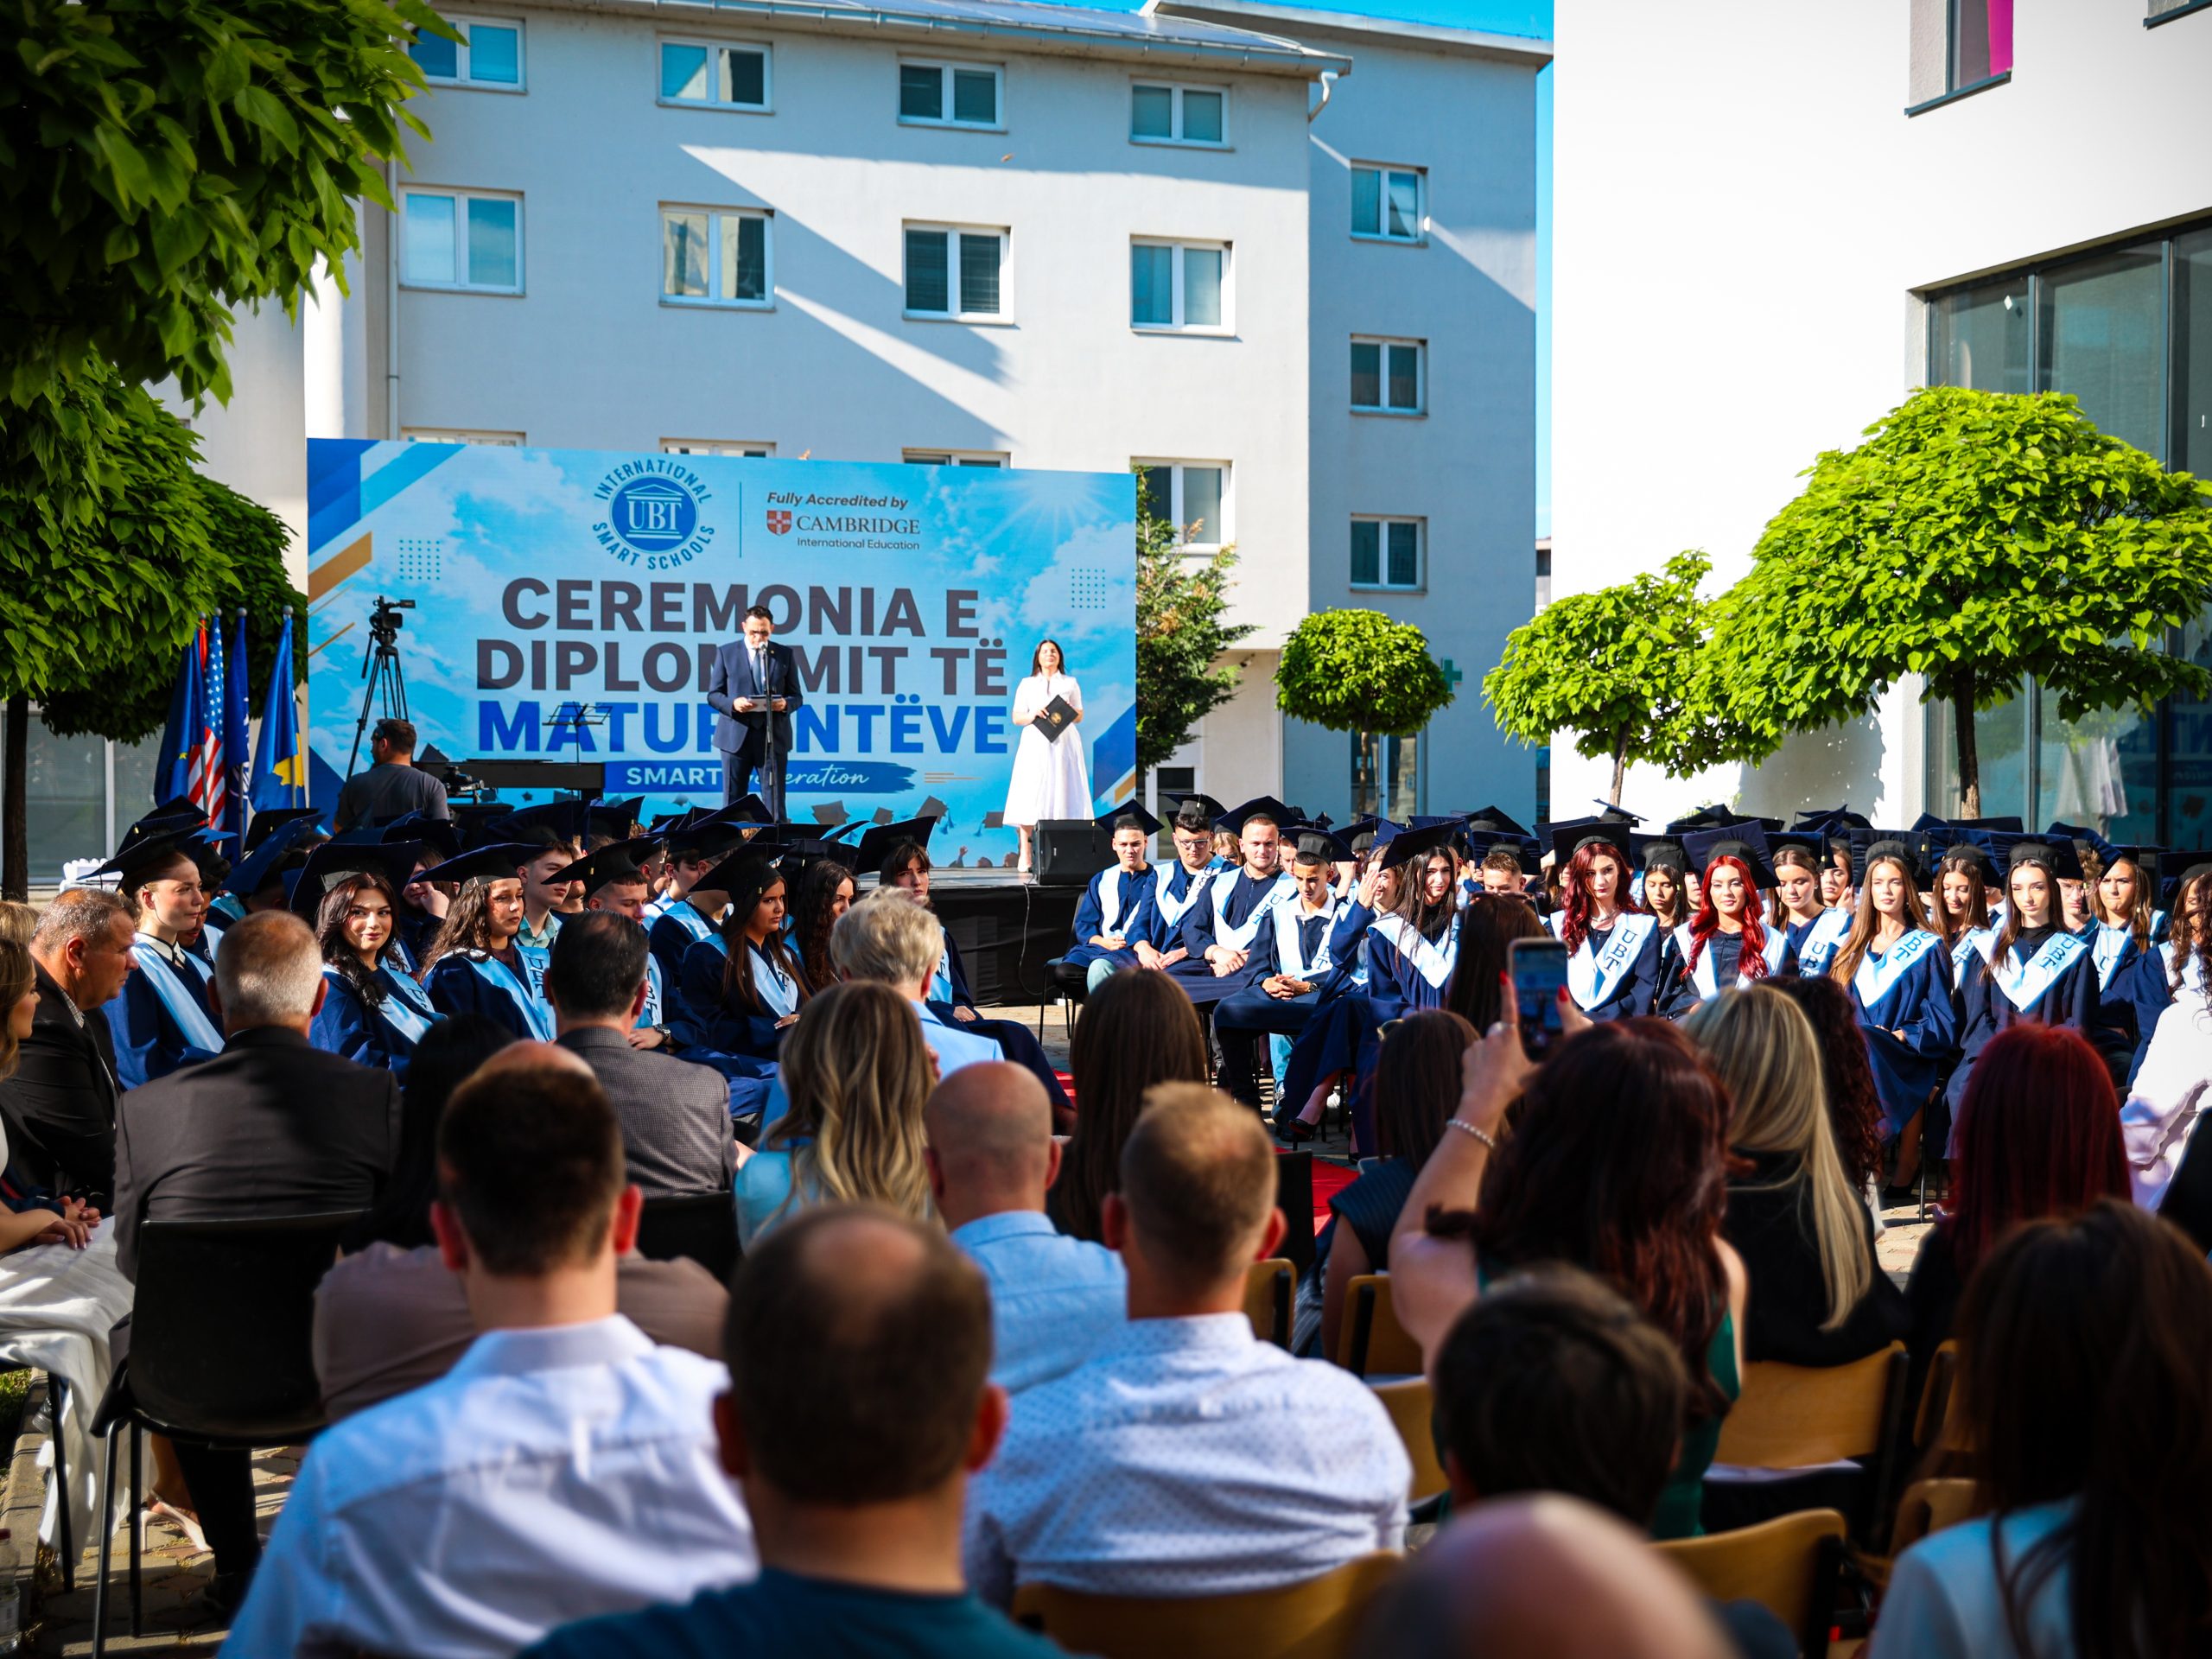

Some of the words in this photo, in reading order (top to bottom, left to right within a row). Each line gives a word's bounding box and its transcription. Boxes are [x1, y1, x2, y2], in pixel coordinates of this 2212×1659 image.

[594, 459, 713, 504] INTERNATIONAL
[628, 500, 683, 531] UBT
[767, 492, 803, 506] Fully
[805, 493, 887, 507] Accredited
[890, 497, 908, 511] by
[797, 516, 921, 535] CAMBRIDGE
[592, 522, 641, 567] SMART
[647, 525, 715, 570] SCHOOLS
[797, 537, 865, 549] International
[868, 539, 921, 550] Education
[501, 576, 926, 638] CEREMONIA
[946, 589, 980, 638] E
[930, 638, 1008, 696] TË
[626, 766, 722, 785] SMART
[1603, 928, 1639, 972] UBT
[1892, 931, 1934, 962] UBT
[2039, 936, 2079, 970] UBT
